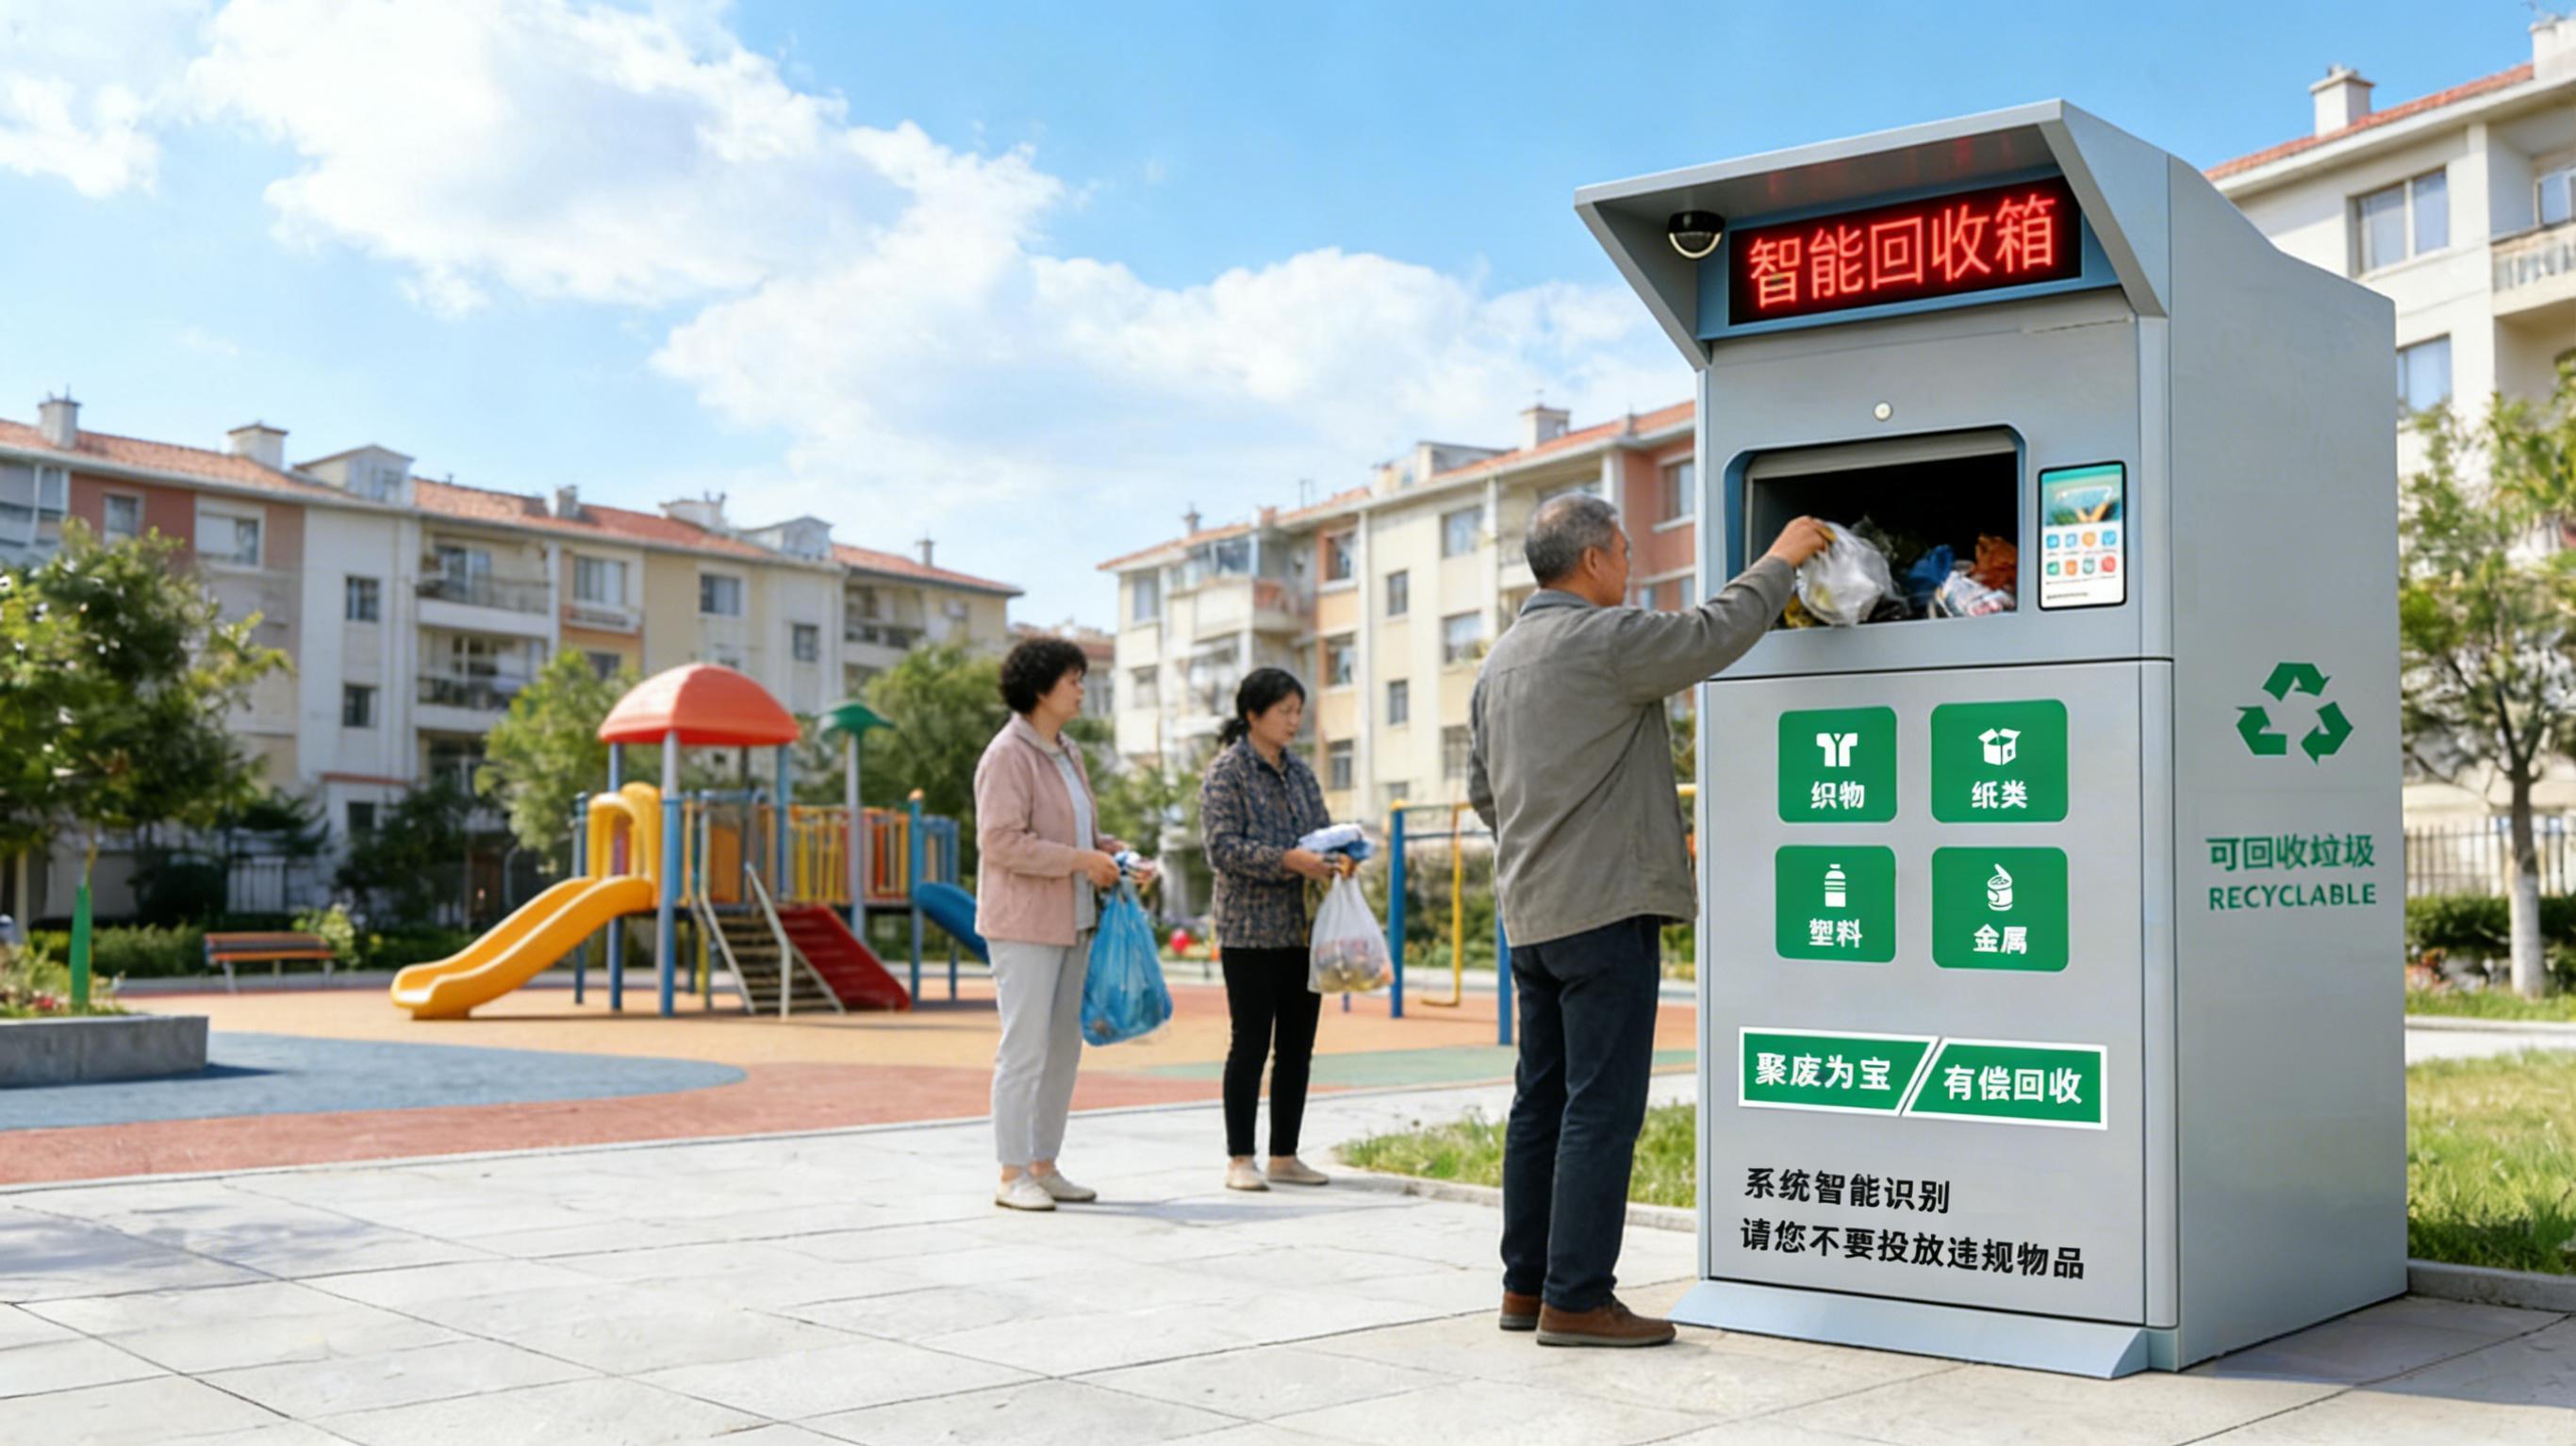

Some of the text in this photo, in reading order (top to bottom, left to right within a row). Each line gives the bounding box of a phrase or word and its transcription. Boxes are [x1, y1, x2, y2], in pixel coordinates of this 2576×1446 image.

[1750, 193, 2056, 308] 智能回收箱
[1810, 781, 1865, 810] 织物
[1972, 780, 2028, 809] 纸类
[2205, 833, 2375, 871] 可回收垃圾
[2208, 882, 2376, 911] RECYCLABLE
[1809, 918, 1863, 948] 塑料
[1973, 923, 2027, 955] 金属
[1756, 1052, 2082, 1104] 聚废为宝 有偿回收
[1744, 1167, 1950, 1214] 系统智能识别
[1741, 1218, 2085, 1280] 请您不要投放违规物品
